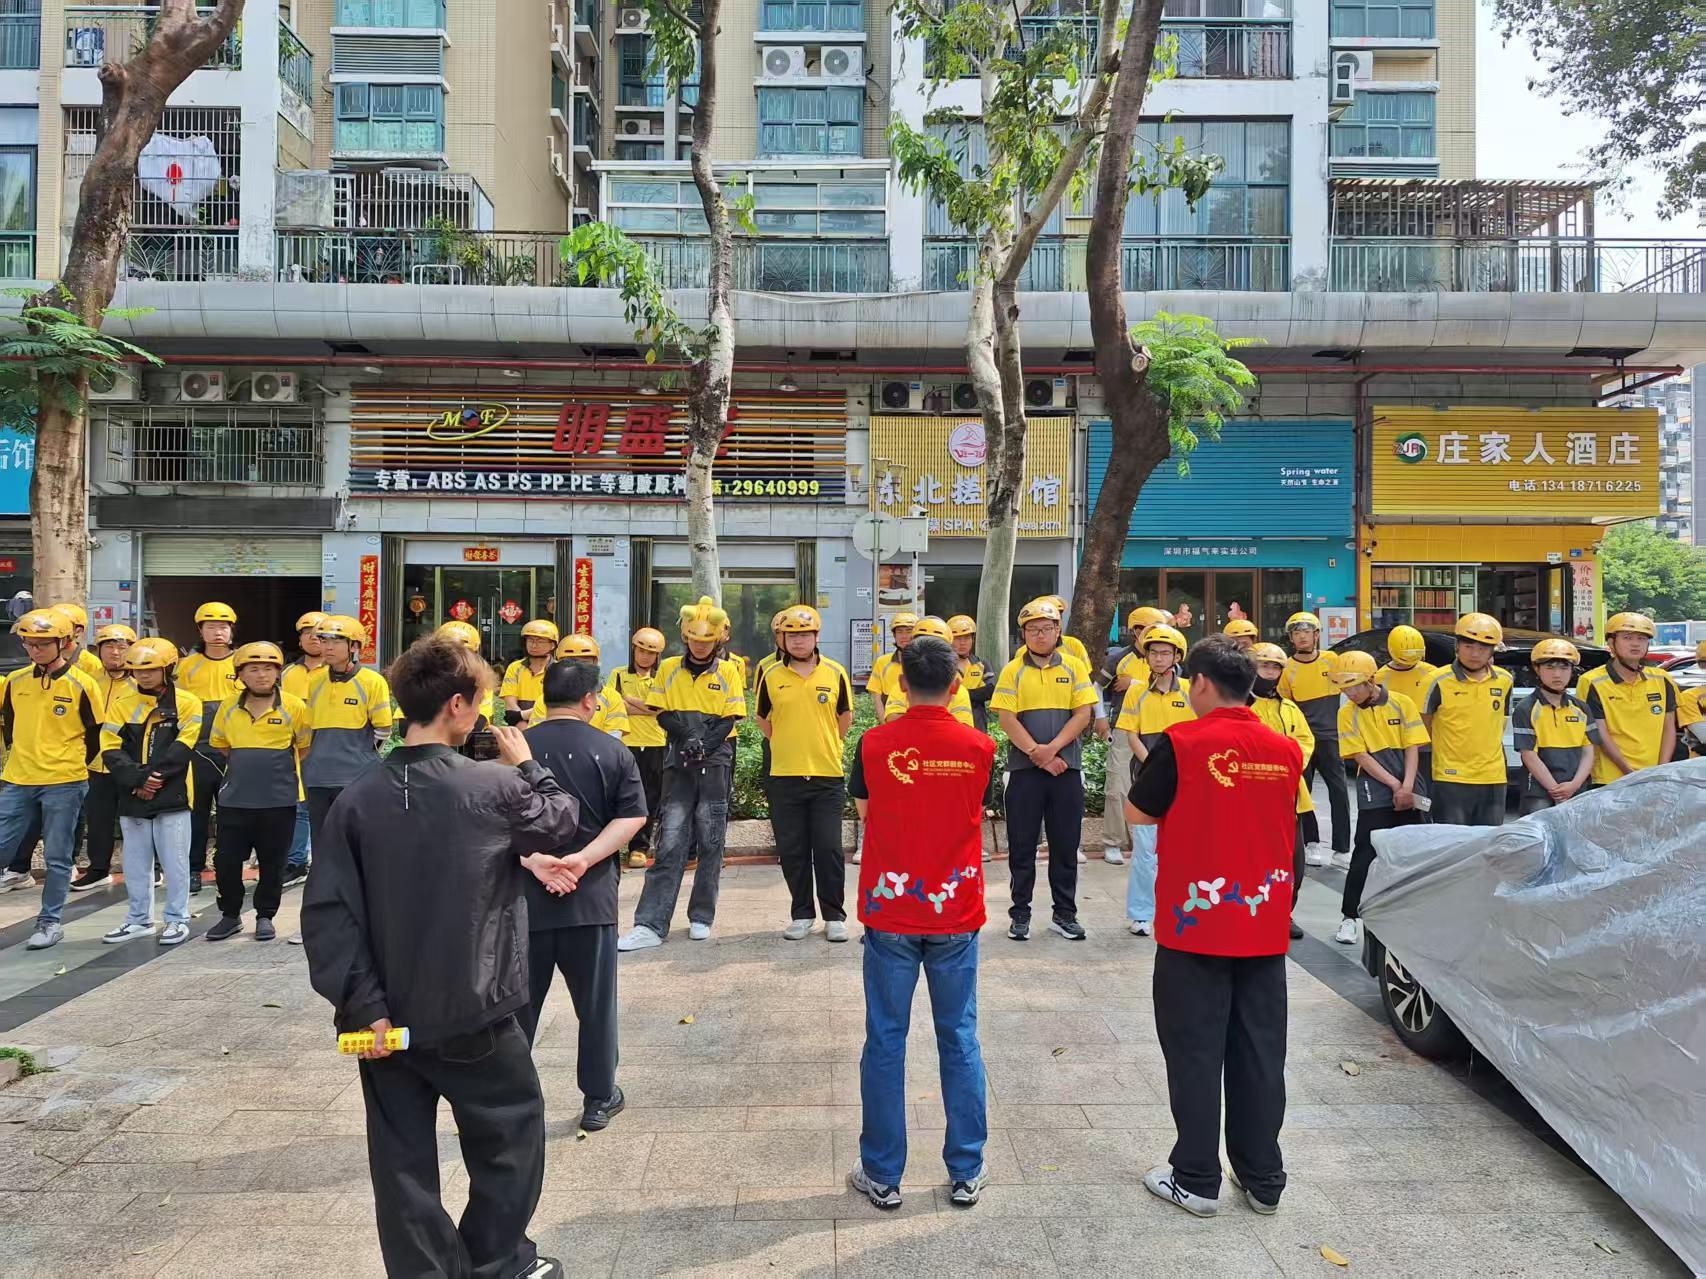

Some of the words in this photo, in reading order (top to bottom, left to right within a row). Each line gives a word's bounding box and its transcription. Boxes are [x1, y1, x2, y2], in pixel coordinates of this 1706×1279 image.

[552, 403, 737, 454] 明盛
[1436, 431, 1641, 465] 庄家人酒庄
[427, 471, 467, 490] ABS
[474, 472, 500, 491] AS
[508, 473, 532, 491] PS
[541, 474, 564, 491] PP
[571, 474, 593, 492] PE
[1280, 467, 1310, 477] Spring
[1509, 479, 1536, 492] 电话
[879, 471, 1062, 507] 东北搓馆
